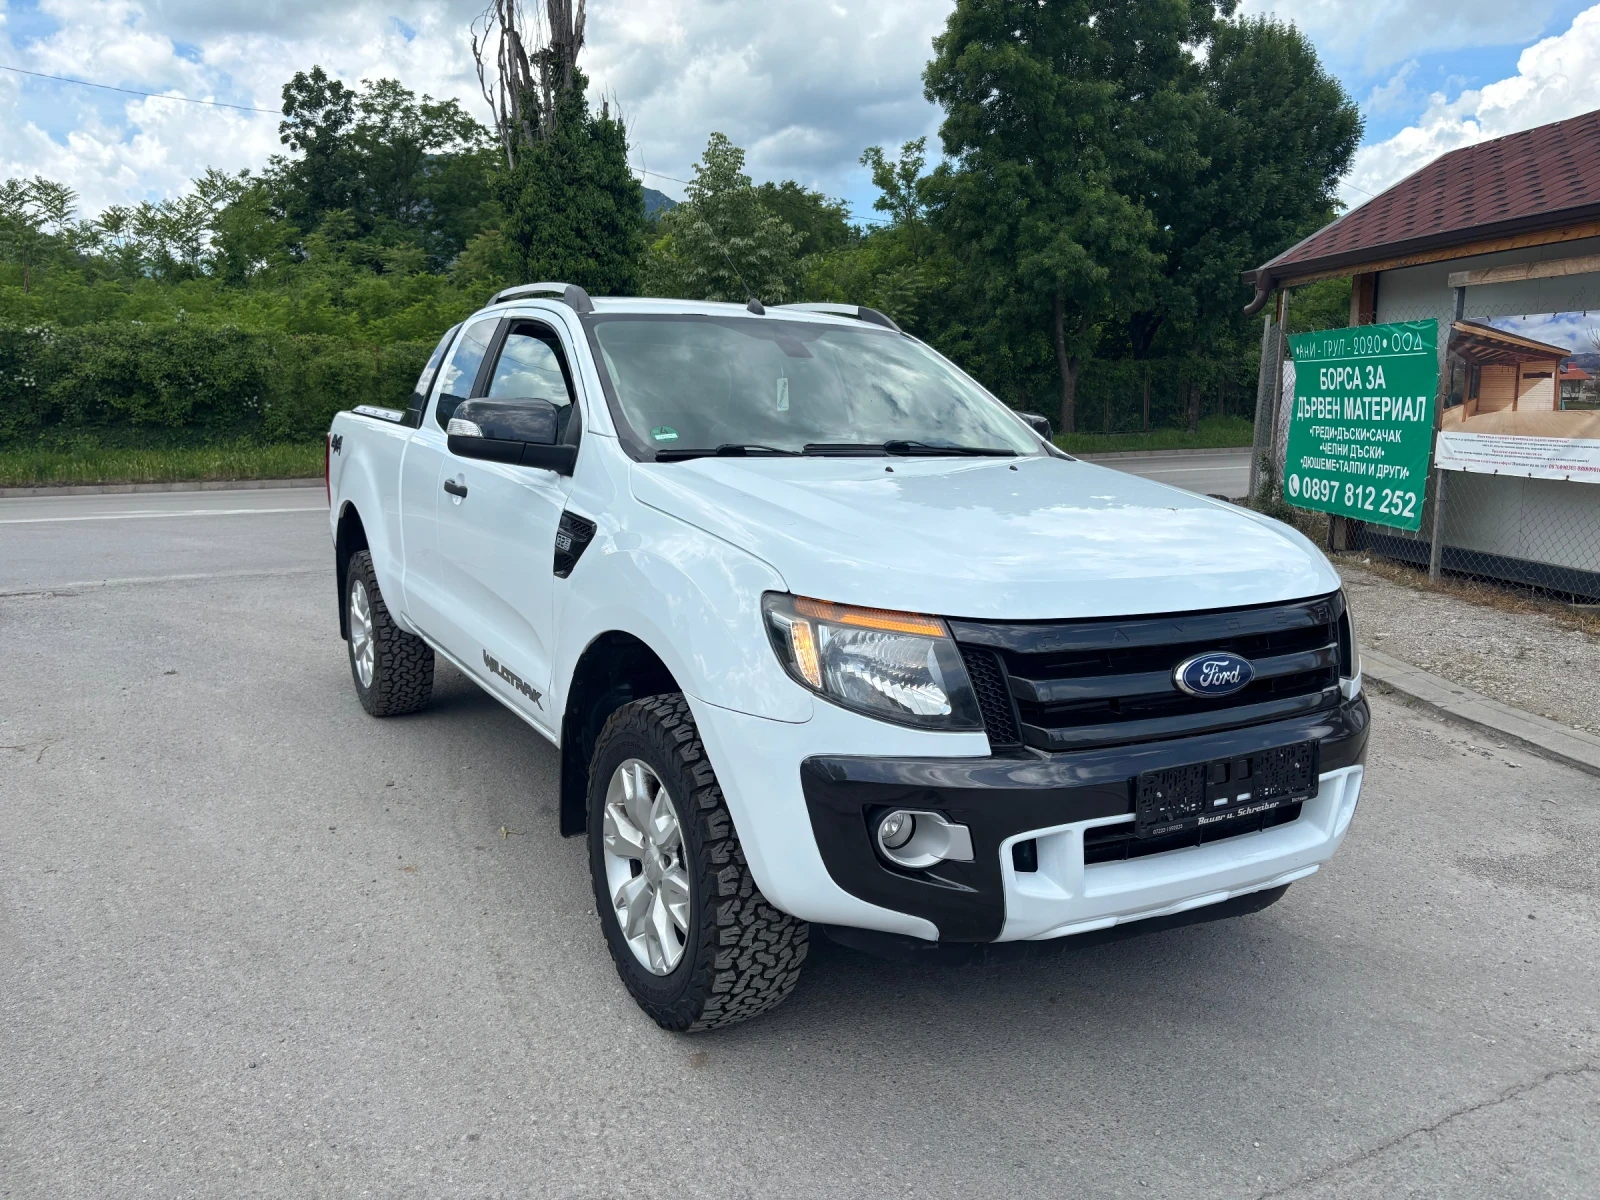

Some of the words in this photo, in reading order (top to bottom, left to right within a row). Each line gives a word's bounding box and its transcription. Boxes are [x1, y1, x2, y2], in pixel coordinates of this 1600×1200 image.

[1391, 331, 1423, 352] ООД
[1320, 366, 1363, 391] БОРСА
[1365, 365, 1387, 390] ЗА
[1296, 396, 1340, 422] ДЪРВЕН
[1344, 396, 1427, 422] МАТЕРИАЛ
[1368, 463, 1375, 476] И
[1302, 476, 1340, 504] 0897
[1344, 482, 1376, 511] 812
[1379, 488, 1417, 518] 252
[482, 648, 545, 712] WILDTRAK
[1199, 660, 1242, 687] Ford
[1197, 815, 1226, 826] Bauer
[1237, 801, 1279, 817] Schreiber
